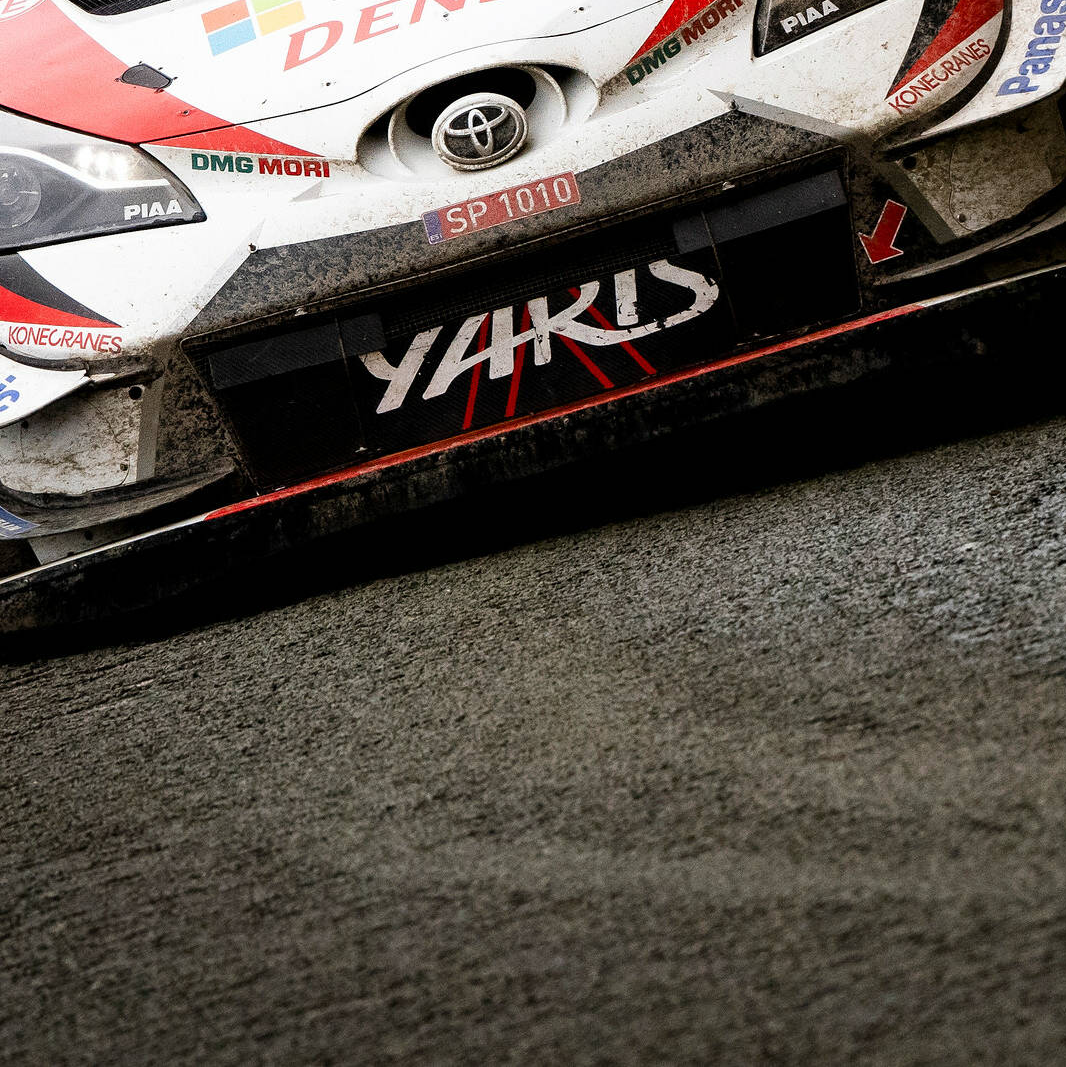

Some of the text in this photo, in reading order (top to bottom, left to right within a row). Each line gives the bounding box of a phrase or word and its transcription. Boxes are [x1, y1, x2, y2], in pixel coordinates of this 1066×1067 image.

[780, 0, 840, 34] PIAA
[626, 40, 682, 86] DMG
[888, 38, 991, 114] KONECRANES
[191, 153, 330, 178] DMG MORI
[124, 199, 183, 220] PIAA
[446, 200, 488, 234] SP
[499, 177, 573, 218] 1010
[8, 325, 122, 356] KONECRANES
[359, 259, 719, 414] YARIS
